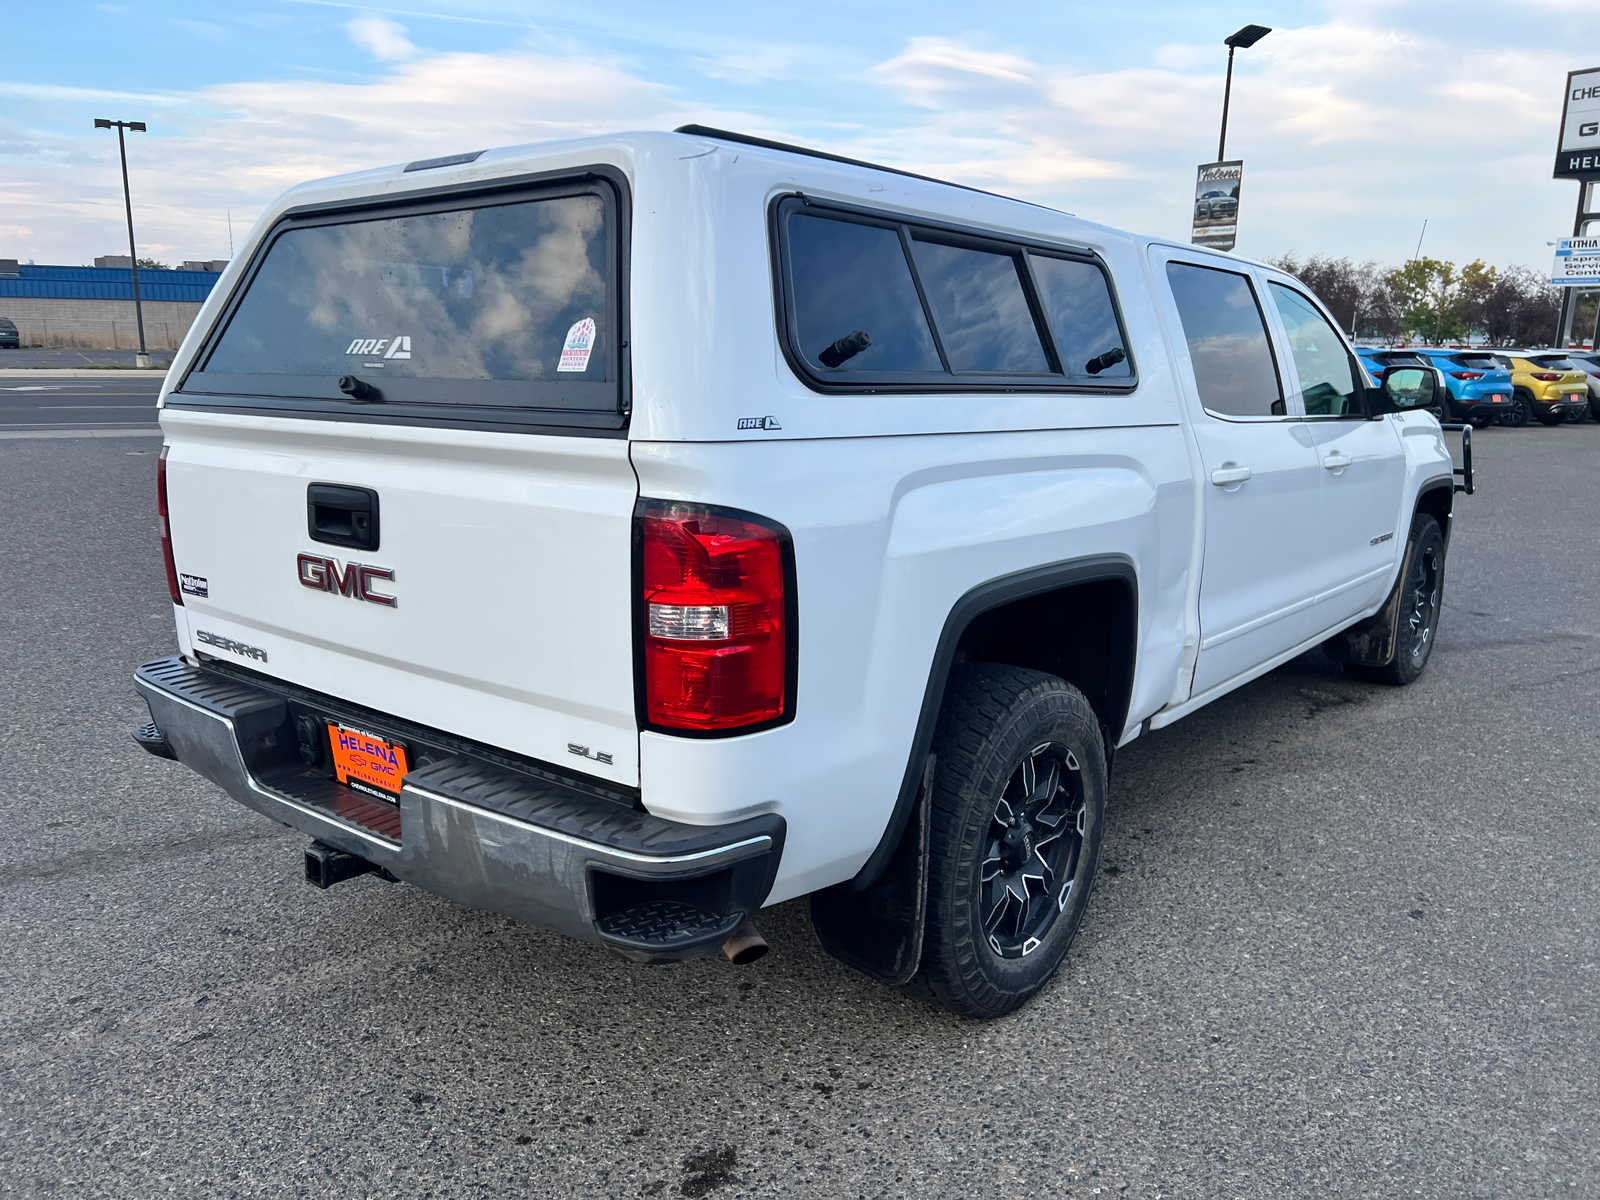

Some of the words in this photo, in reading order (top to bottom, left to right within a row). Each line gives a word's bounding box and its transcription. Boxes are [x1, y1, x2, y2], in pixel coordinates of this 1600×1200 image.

[1569, 240, 1599, 249] LITHIA
[297, 551, 398, 609] GMC
[196, 629, 268, 664] SIERRA
[338, 733, 400, 771] HELENA
[370, 761, 396, 777] GMC
